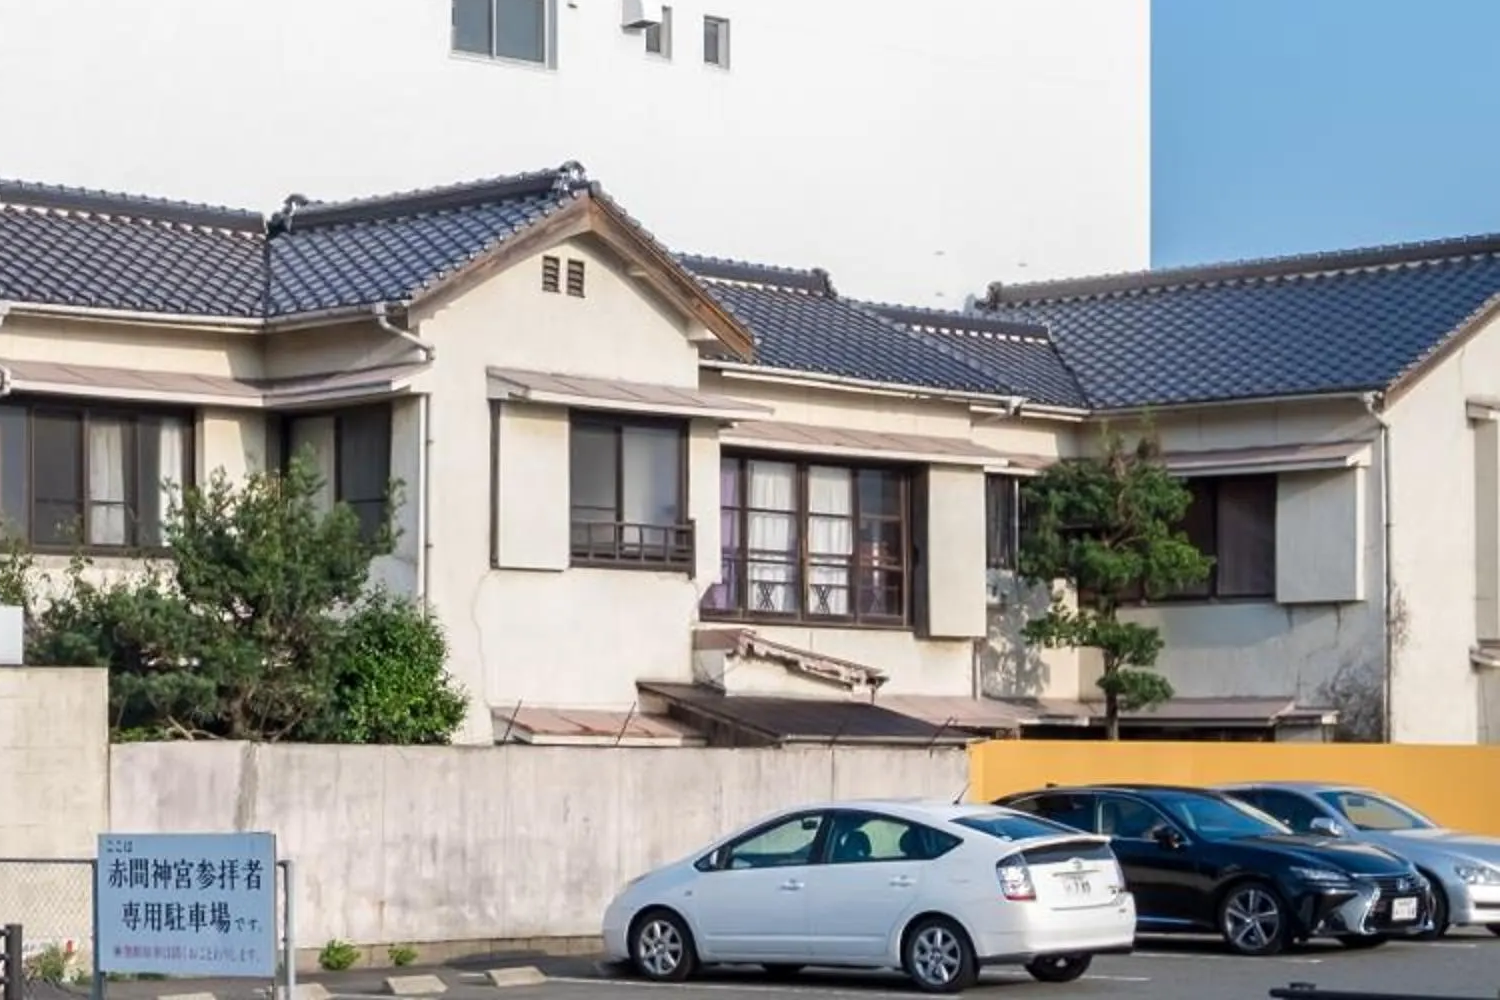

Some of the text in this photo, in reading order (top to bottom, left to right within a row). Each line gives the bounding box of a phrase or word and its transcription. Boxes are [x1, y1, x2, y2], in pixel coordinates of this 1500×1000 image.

[106, 840, 133, 853] ここは
[108, 857, 264, 891] 赤間神宮参拝者
